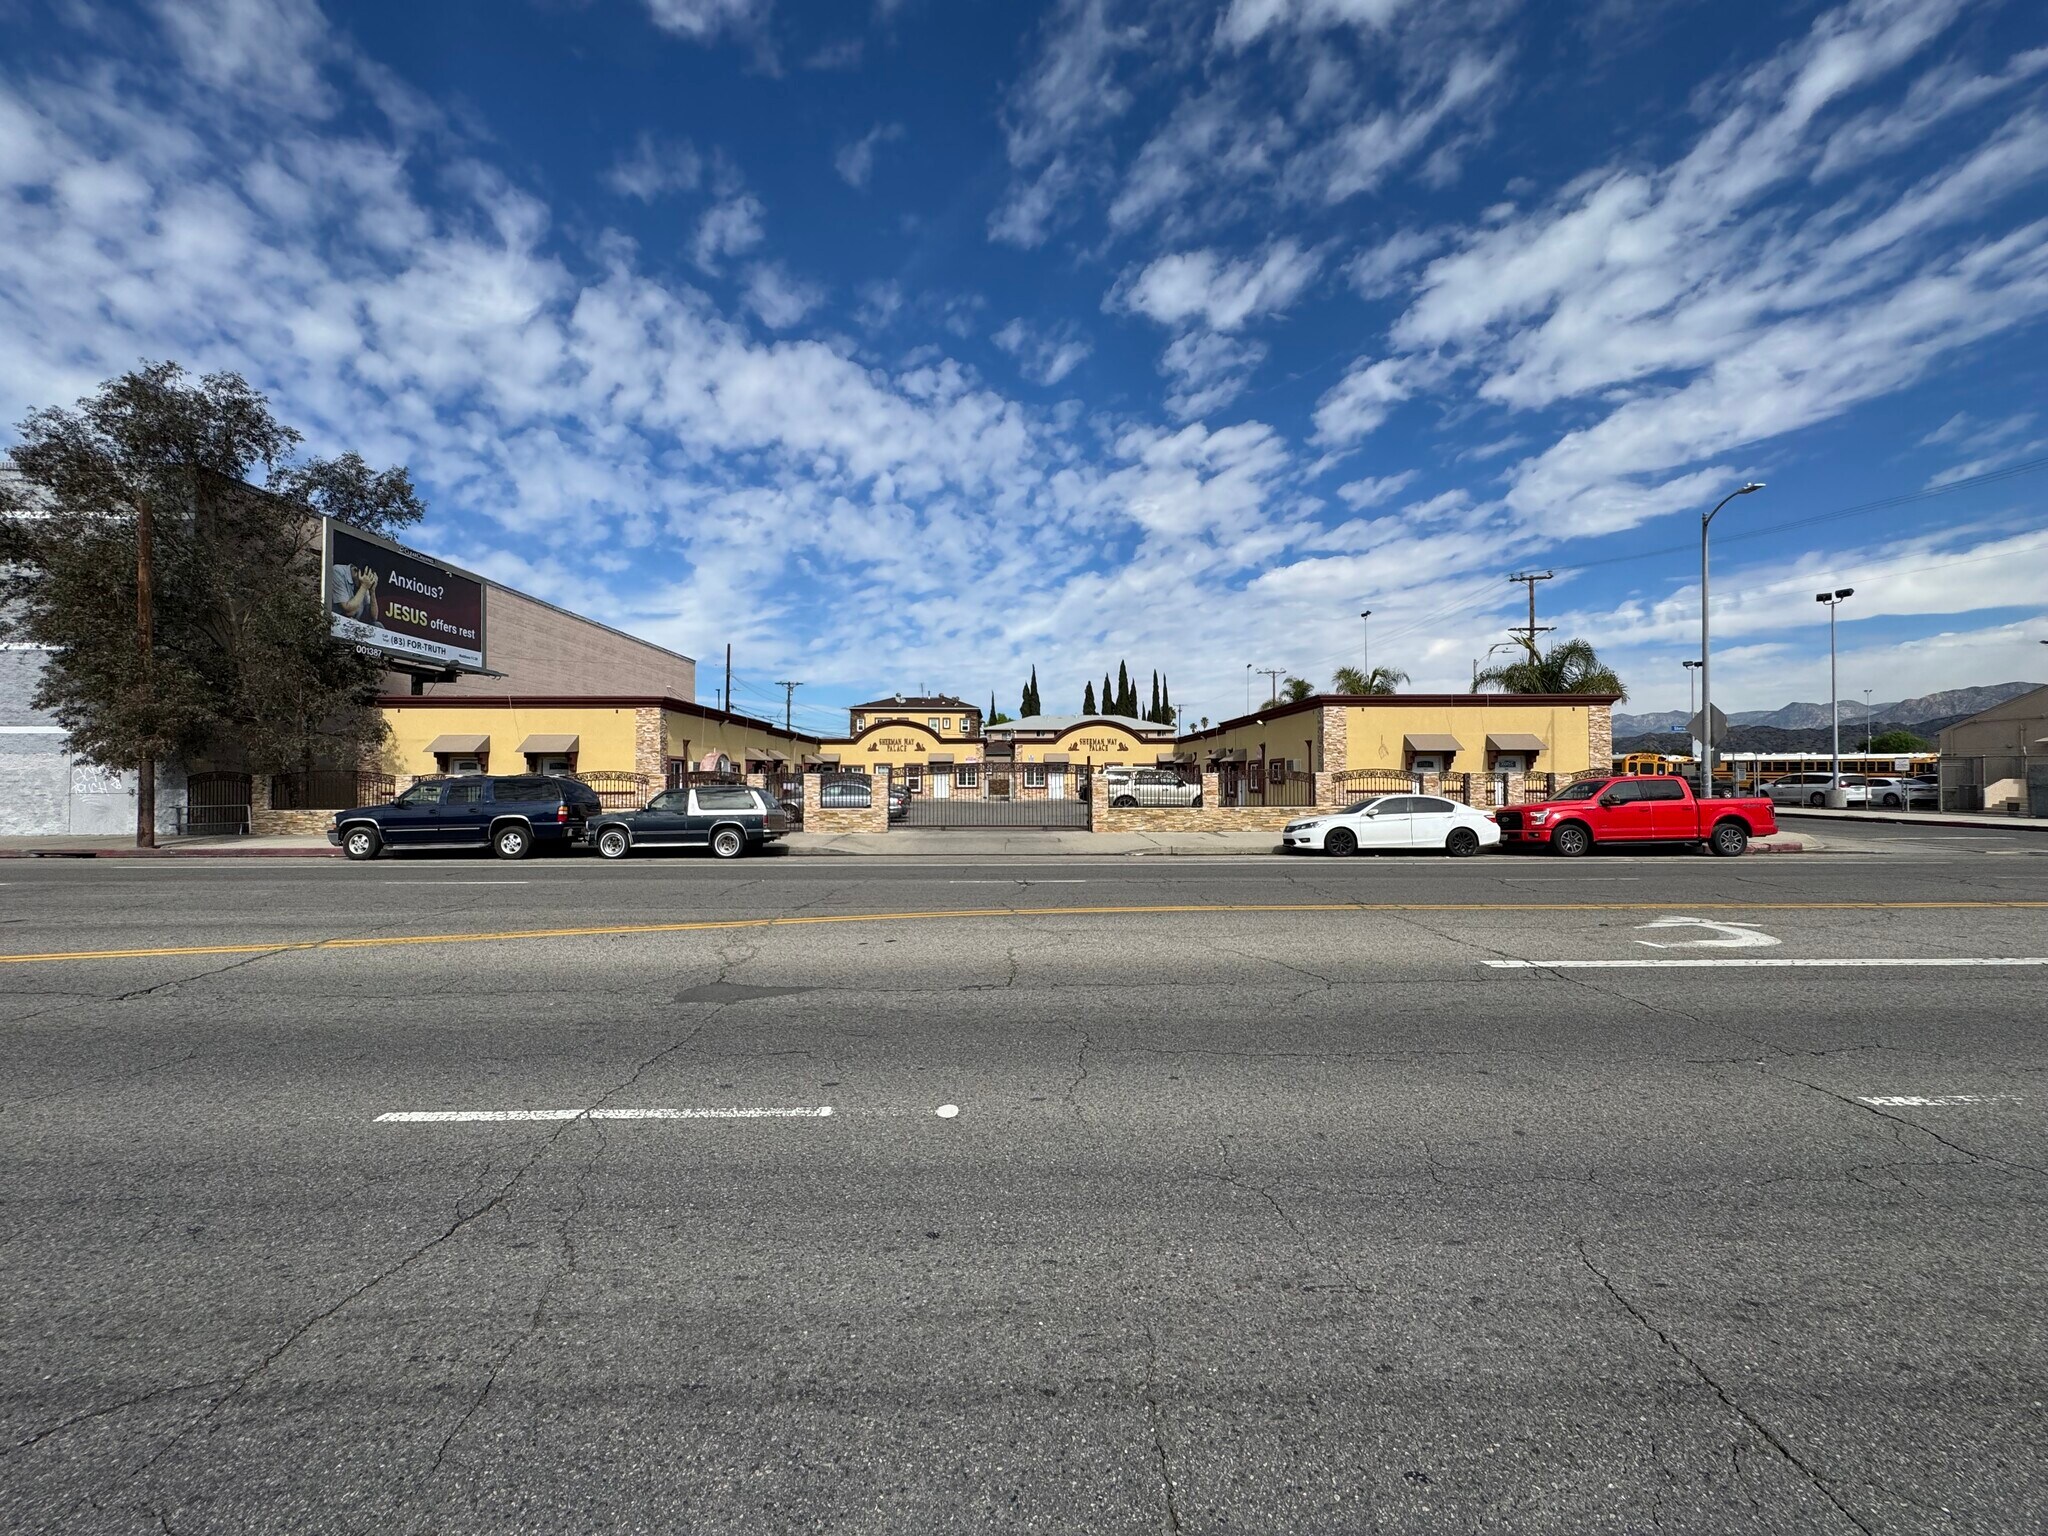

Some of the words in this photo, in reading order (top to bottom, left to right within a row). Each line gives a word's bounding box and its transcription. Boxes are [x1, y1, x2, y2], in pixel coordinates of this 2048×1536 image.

[388, 570, 444, 599] Anxious?
[385, 602, 428, 626] JESUS
[430, 618, 457, 635] offers
[459, 627, 475, 639] rest
[356, 644, 382, 657] 001387
[390, 635, 405, 648] (83)
[407, 639, 446, 655] FOR-TRUTH
